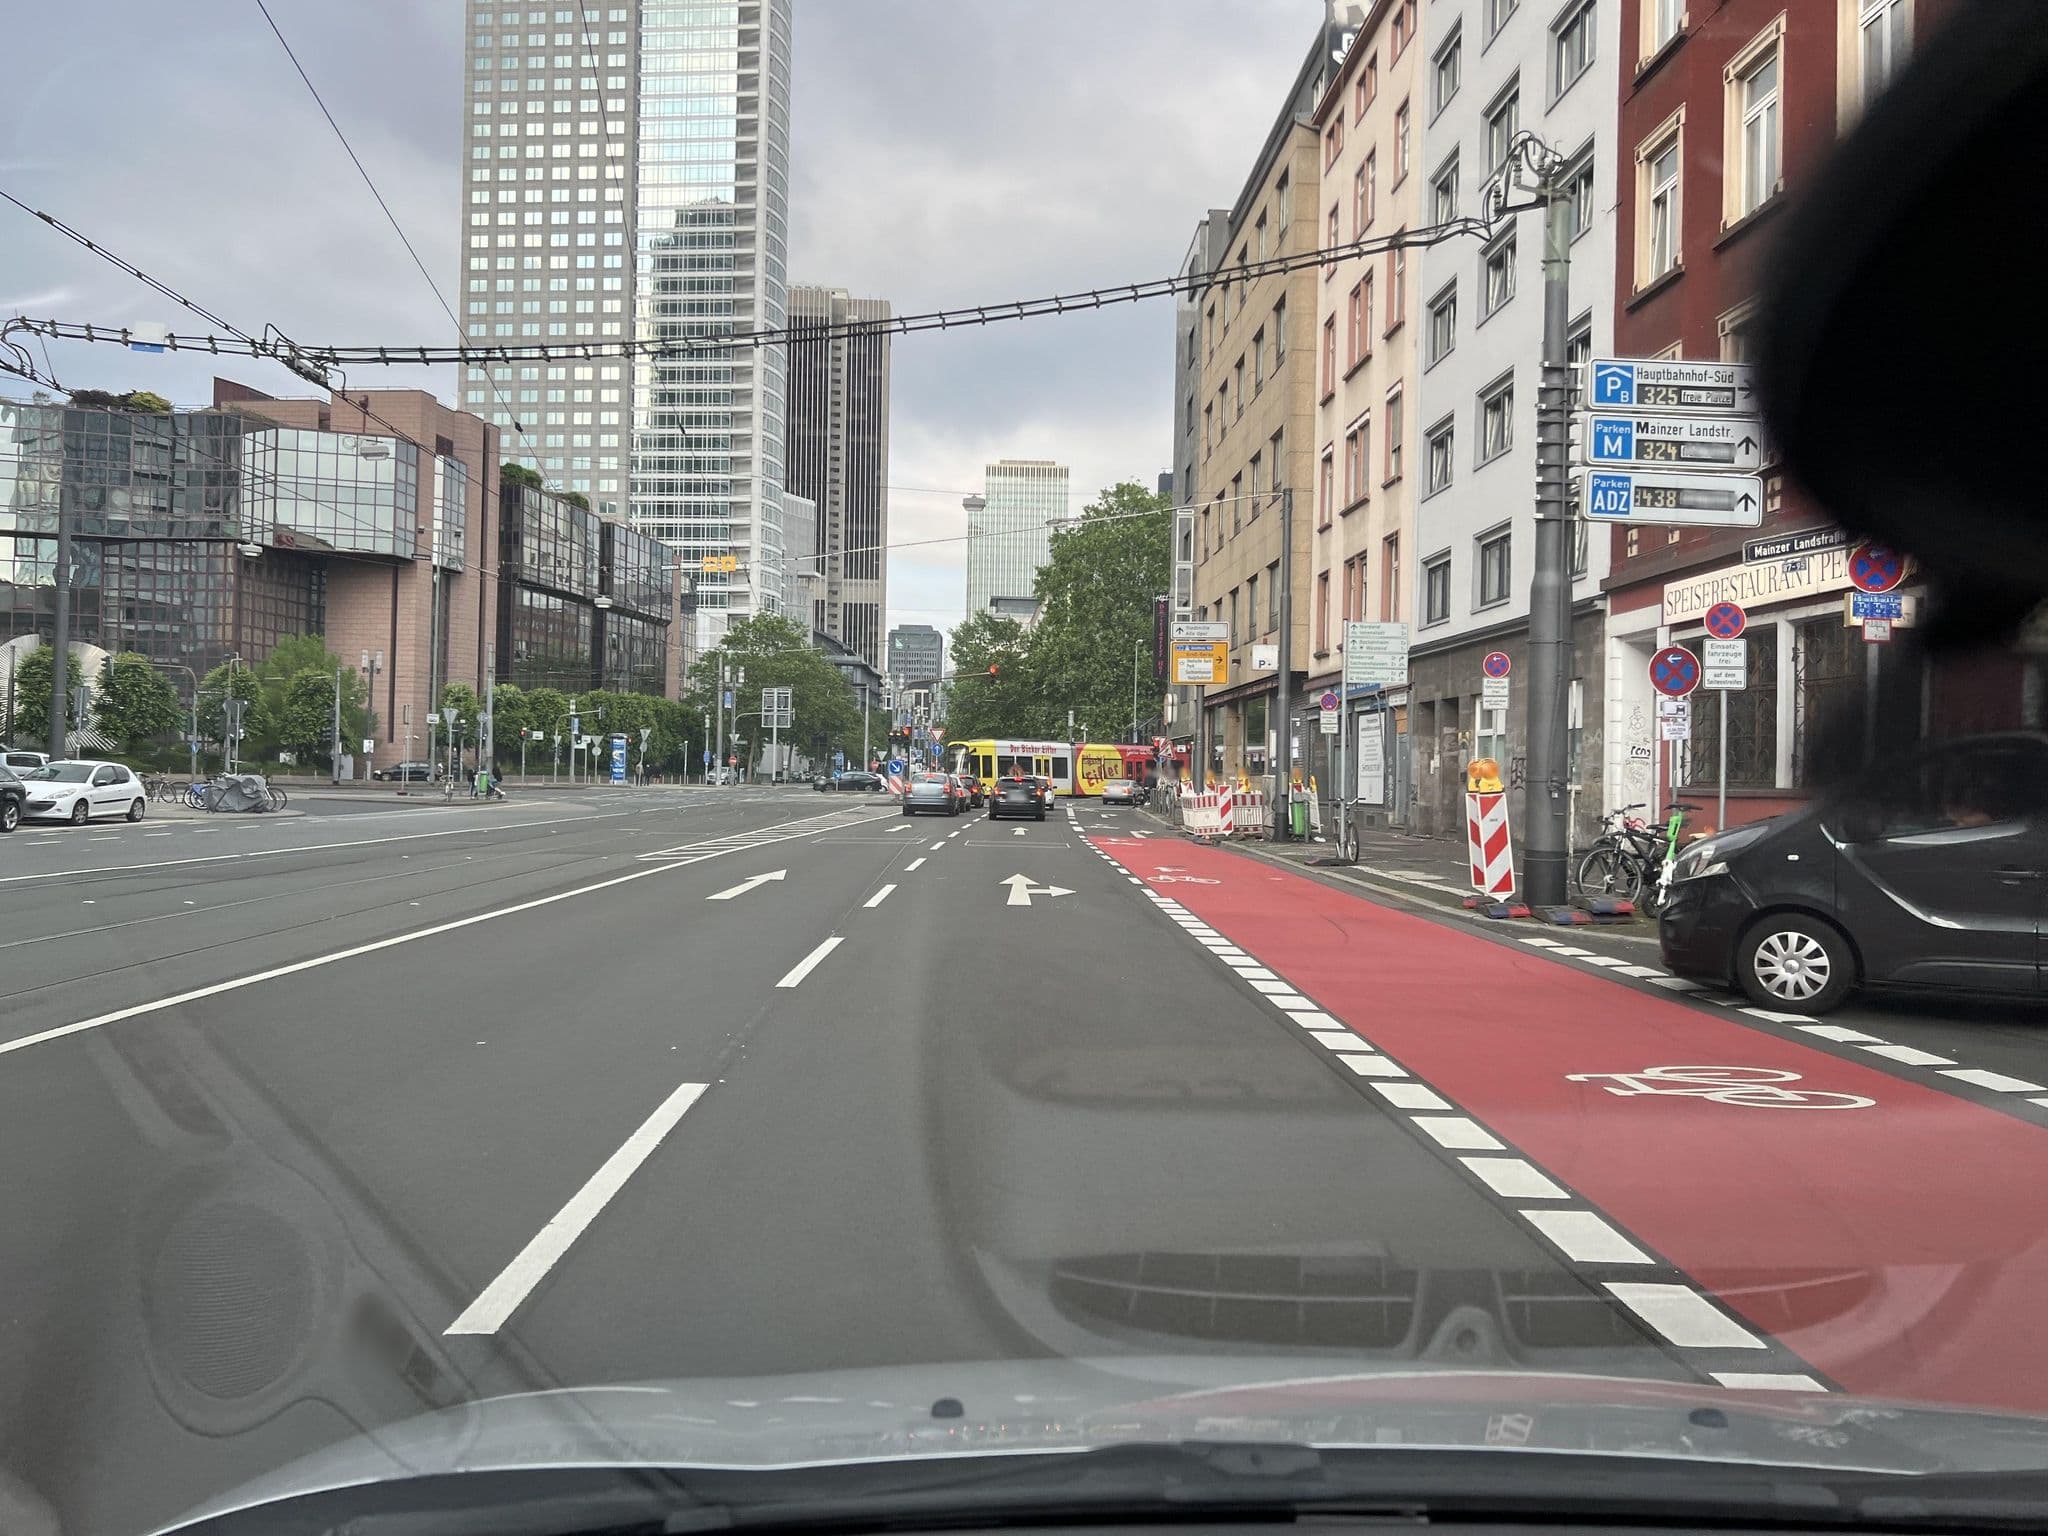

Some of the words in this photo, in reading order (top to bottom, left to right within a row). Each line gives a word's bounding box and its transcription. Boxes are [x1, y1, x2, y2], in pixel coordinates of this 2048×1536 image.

[1637, 367, 1734, 384] Hauptbahnhof-Süd
[1644, 386, 1678, 405] 325
[1596, 424, 1631, 434] Parken
[1636, 421, 1683, 436] Mainzer
[1689, 424, 1734, 438] Landstr.
[1603, 435, 1622, 456] M
[1643, 441, 1678, 460] 324
[1593, 479, 1630, 489] Parken
[1594, 490, 1629, 512] ADZ
[1754, 543, 1790, 558] Mainzer
[1666, 555, 1813, 617] SPEISERESTAURANT
[1820, 550, 1849, 582] PE
